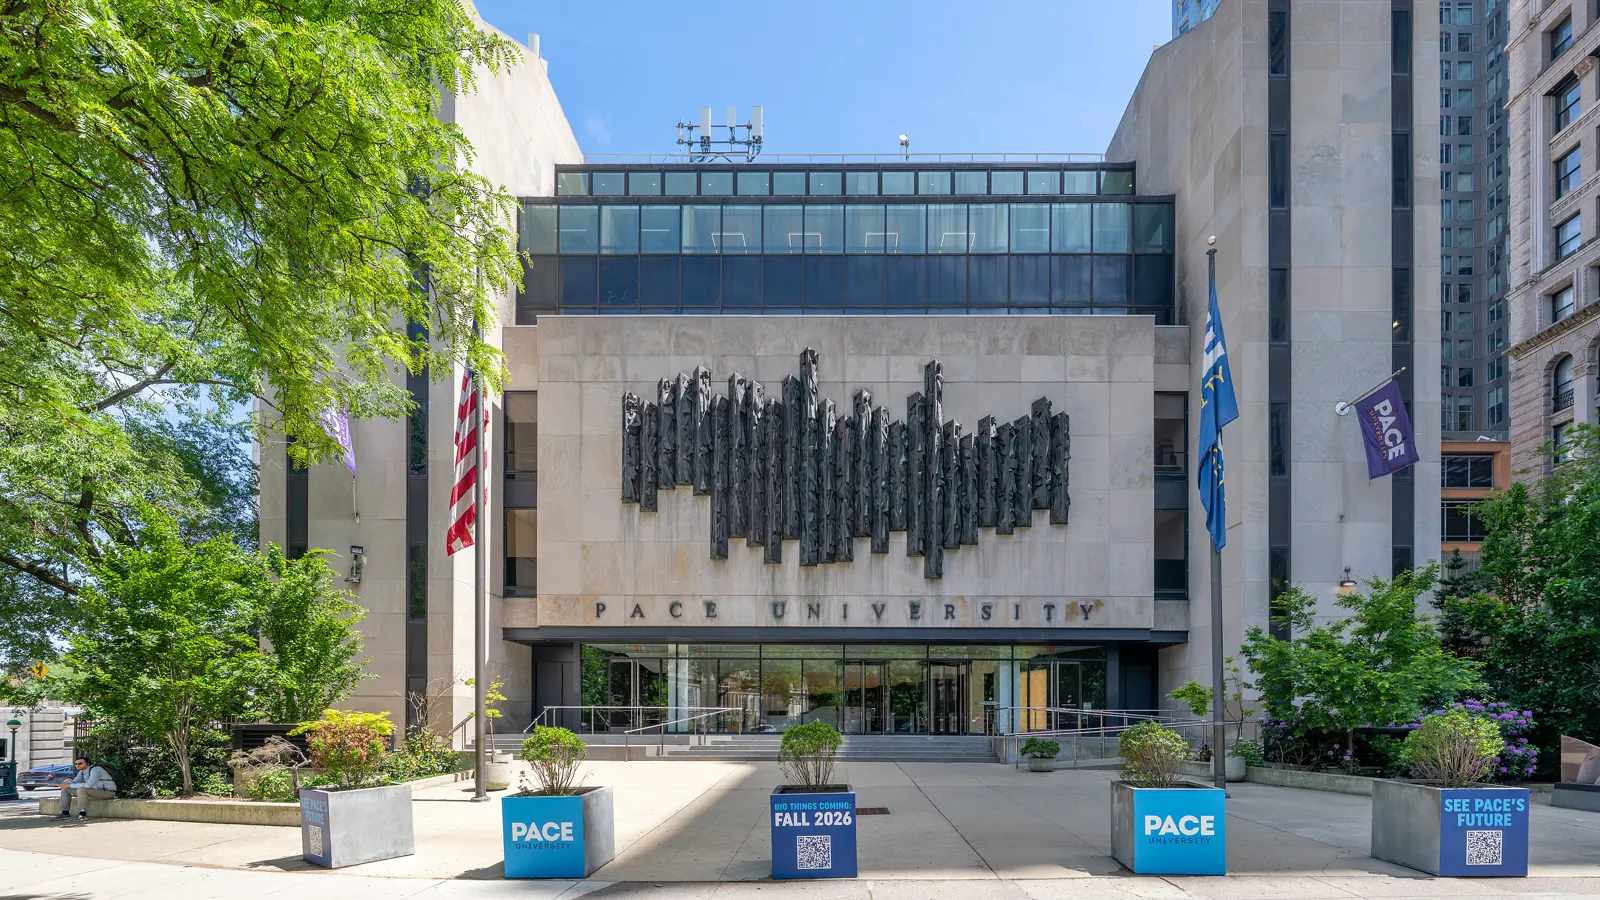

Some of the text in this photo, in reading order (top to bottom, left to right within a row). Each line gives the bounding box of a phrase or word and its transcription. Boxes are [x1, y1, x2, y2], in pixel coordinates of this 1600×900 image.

[1374, 399, 1405, 460] PACE
[595, 601, 1094, 620] PACE UNIVERSITY
[774, 802, 852, 811] BIG THINGS COMING:
[1444, 798, 1525, 812] SEE PACE'S
[774, 811, 852, 827] FALL 2026
[1144, 814, 1215, 836] PACE
[1457, 813, 1512, 827] FUTURE
[511, 821, 574, 842] PACE
[515, 842, 571, 850] UNIVERSITY
